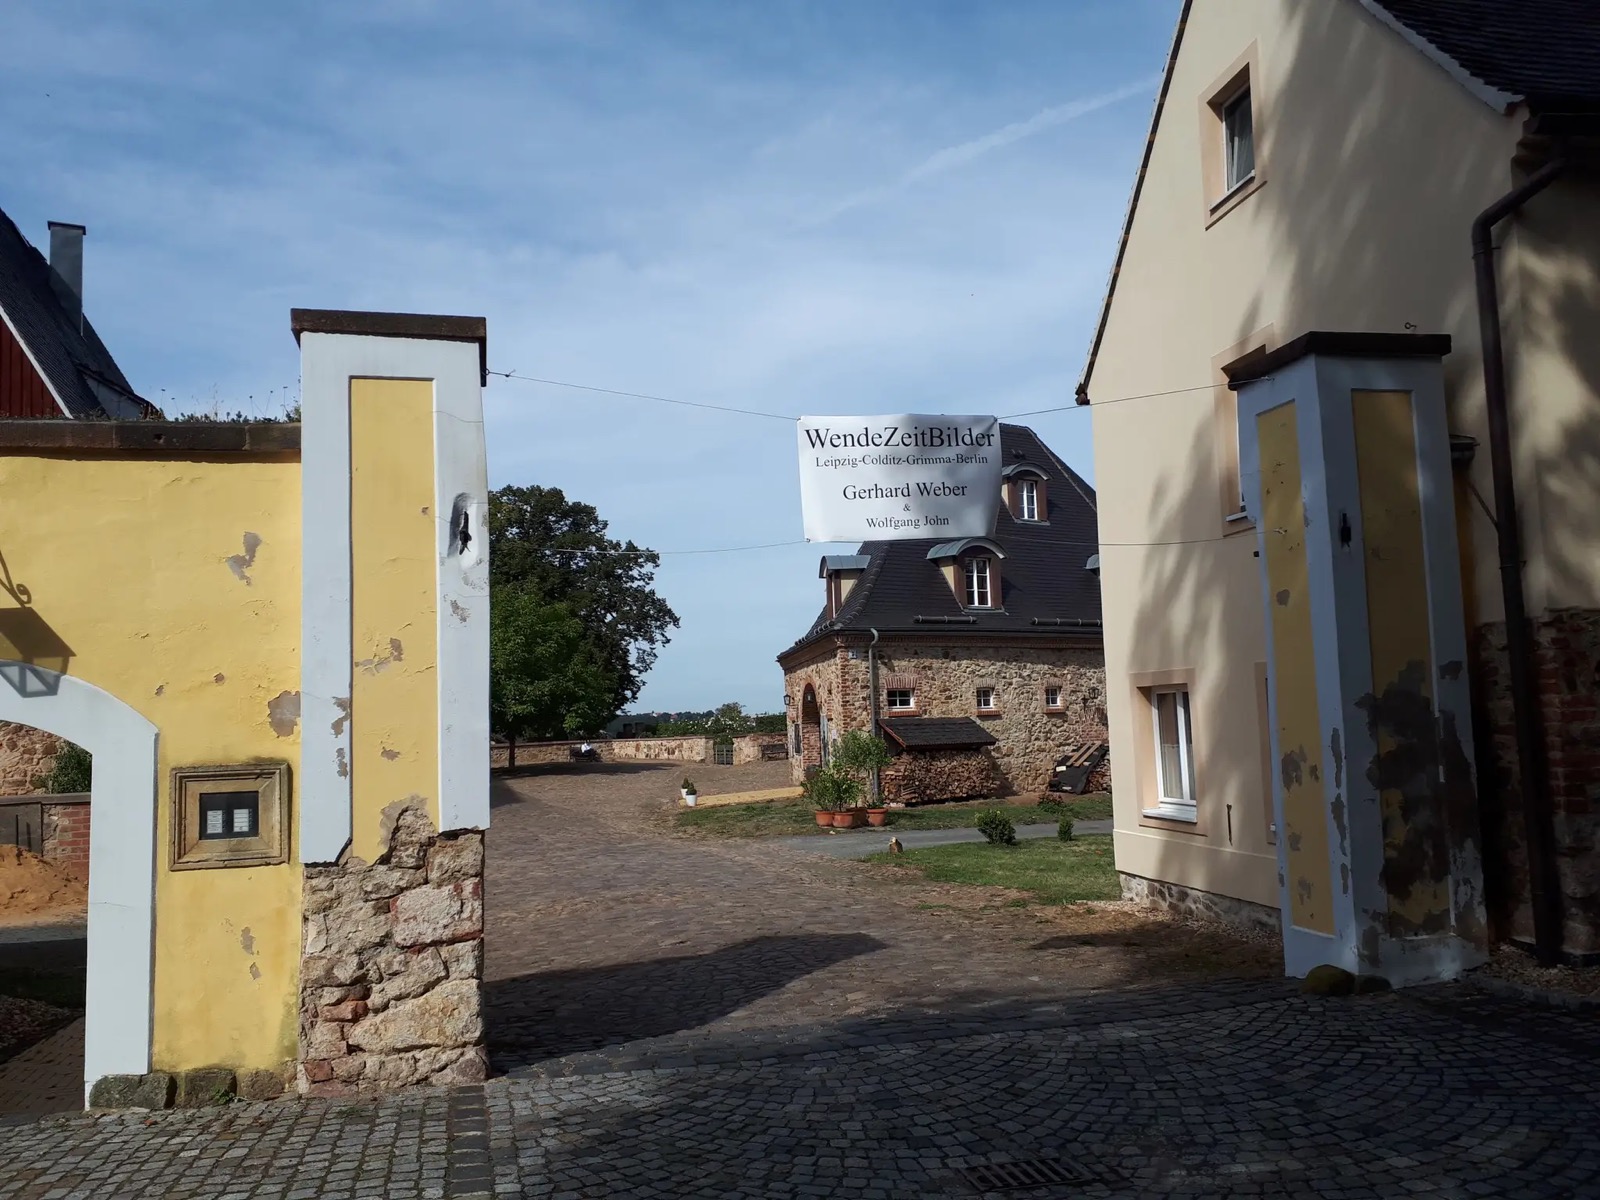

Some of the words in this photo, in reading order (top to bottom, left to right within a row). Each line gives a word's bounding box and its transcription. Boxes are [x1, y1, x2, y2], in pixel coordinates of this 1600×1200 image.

[804, 426, 995, 449] WendeZeitBilder
[815, 453, 988, 469] Leipzig-Colditz-Grimma-Berlin
[843, 483, 911, 500] Gerhard
[916, 482, 968, 497] Weber
[903, 504, 911, 512] &
[866, 517, 920, 530] Wolfgang
[923, 515, 950, 526] John
